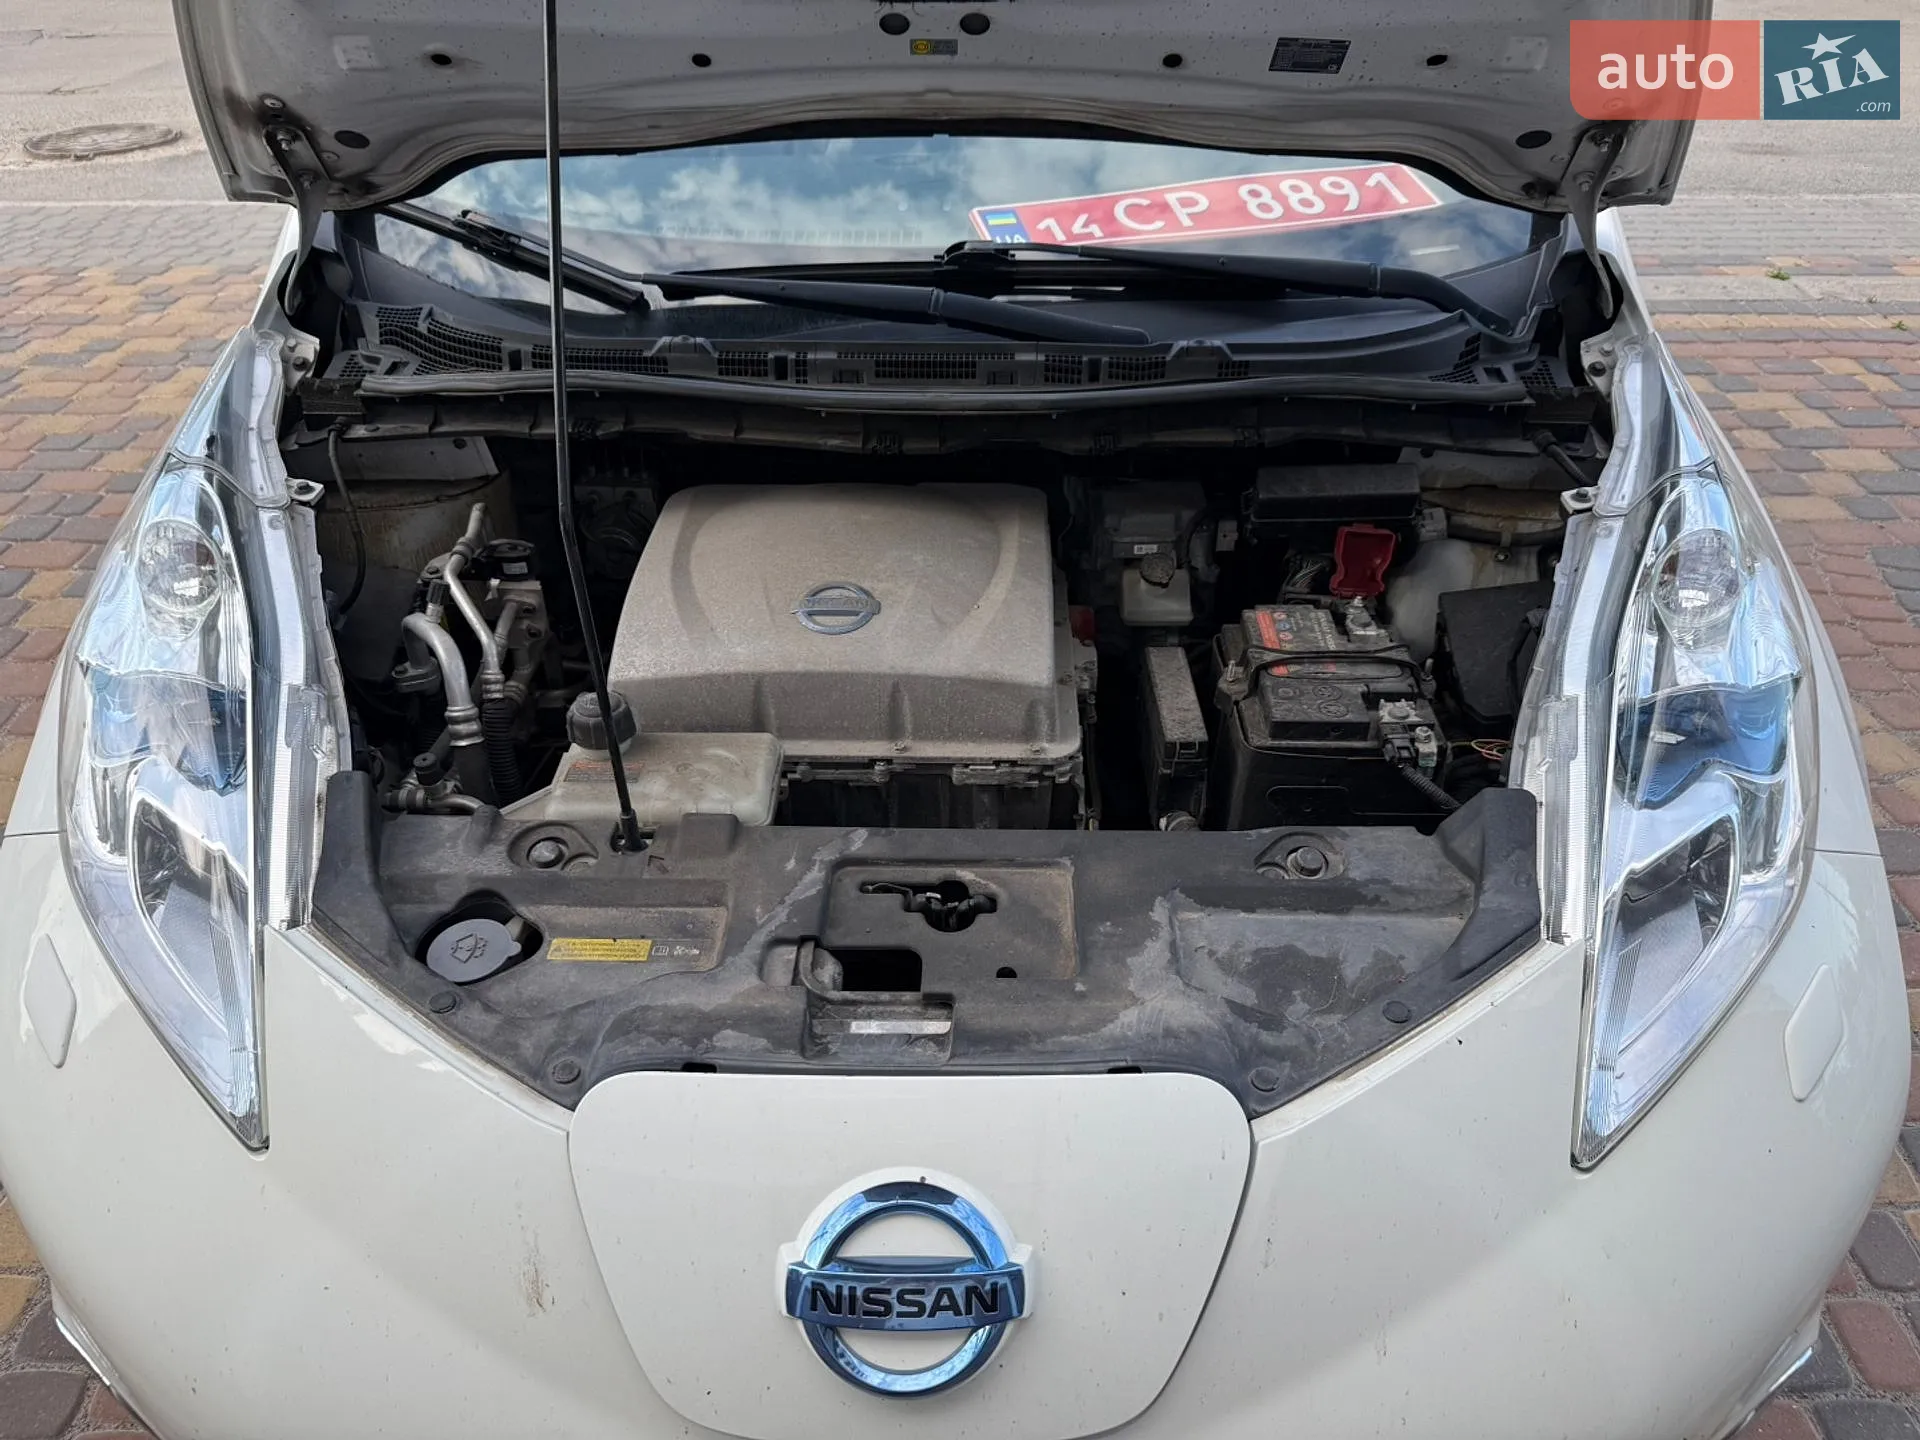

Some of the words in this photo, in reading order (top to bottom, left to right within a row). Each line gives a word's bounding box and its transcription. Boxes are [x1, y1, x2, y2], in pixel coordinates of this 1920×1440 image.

[1036, 213, 1104, 241] 14
[1114, 191, 1209, 231] CP
[1238, 172, 1409, 220] 8891
[809, 1280, 1000, 1319] NISSAN
